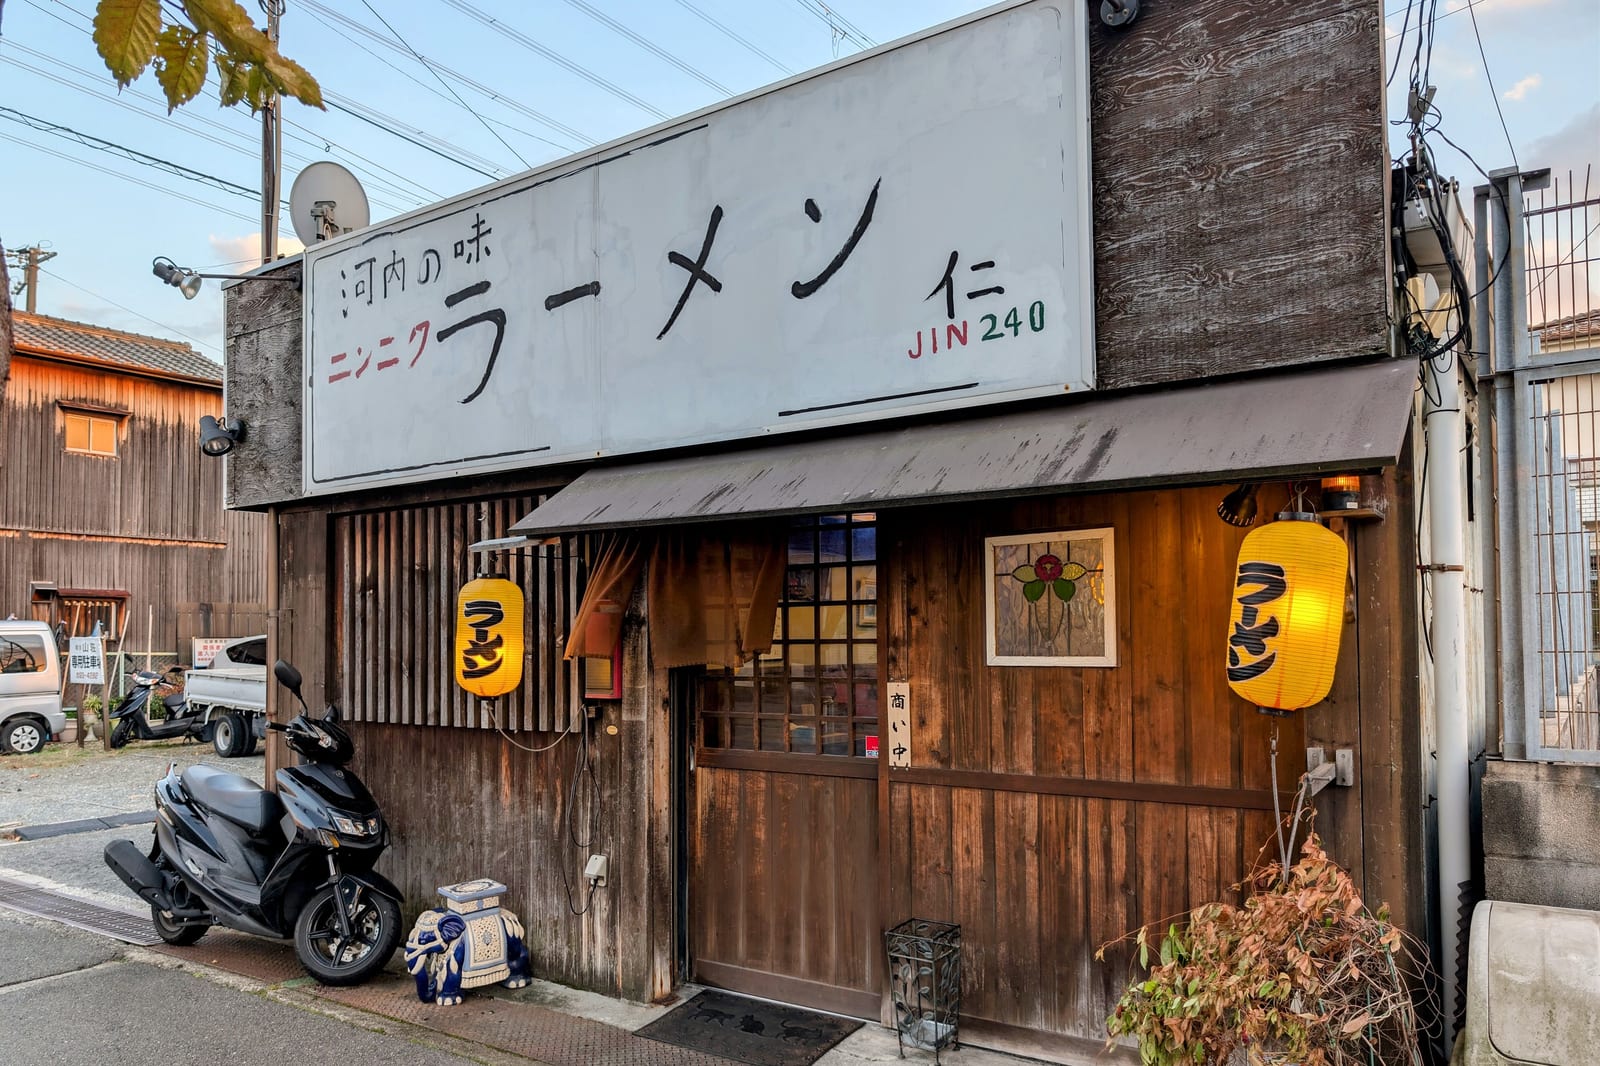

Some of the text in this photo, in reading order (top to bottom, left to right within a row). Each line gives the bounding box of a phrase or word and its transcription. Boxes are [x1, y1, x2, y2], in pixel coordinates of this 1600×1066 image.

[328, 176, 882, 404] ニンニク ラーメン
[341, 213, 492, 318] 河内の味
[924, 250, 1005, 319] 仁
[908, 300, 1045, 359] JIN 240
[462, 599, 504, 680] ラーメン
[1226, 560, 1287, 683] ラーメン
[890, 692, 907, 761] 商い中
